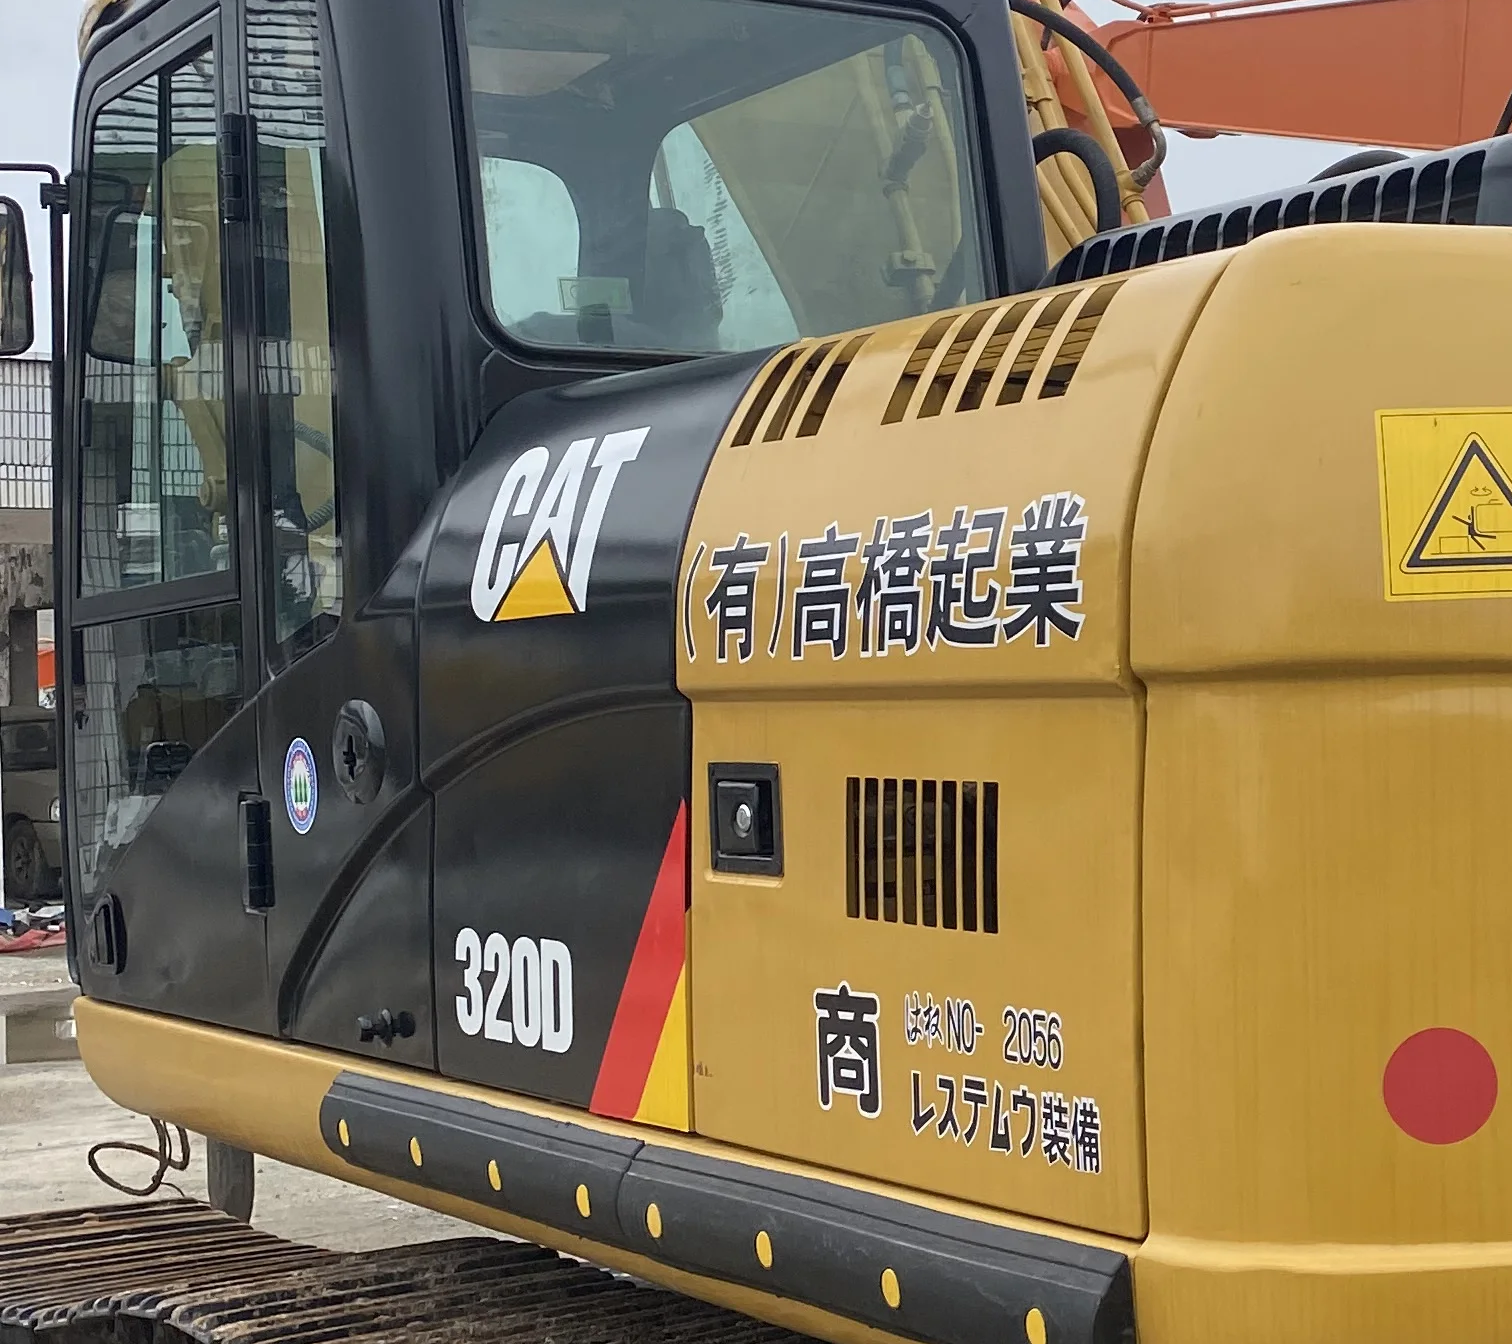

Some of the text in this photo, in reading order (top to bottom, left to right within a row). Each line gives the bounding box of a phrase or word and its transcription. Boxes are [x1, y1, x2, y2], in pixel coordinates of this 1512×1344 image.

[471, 426, 650, 621] CAT
[455, 926, 574, 1054] 320D
[813, 982, 882, 1119] 商
[1003, 1005, 1064, 1071] 2056
